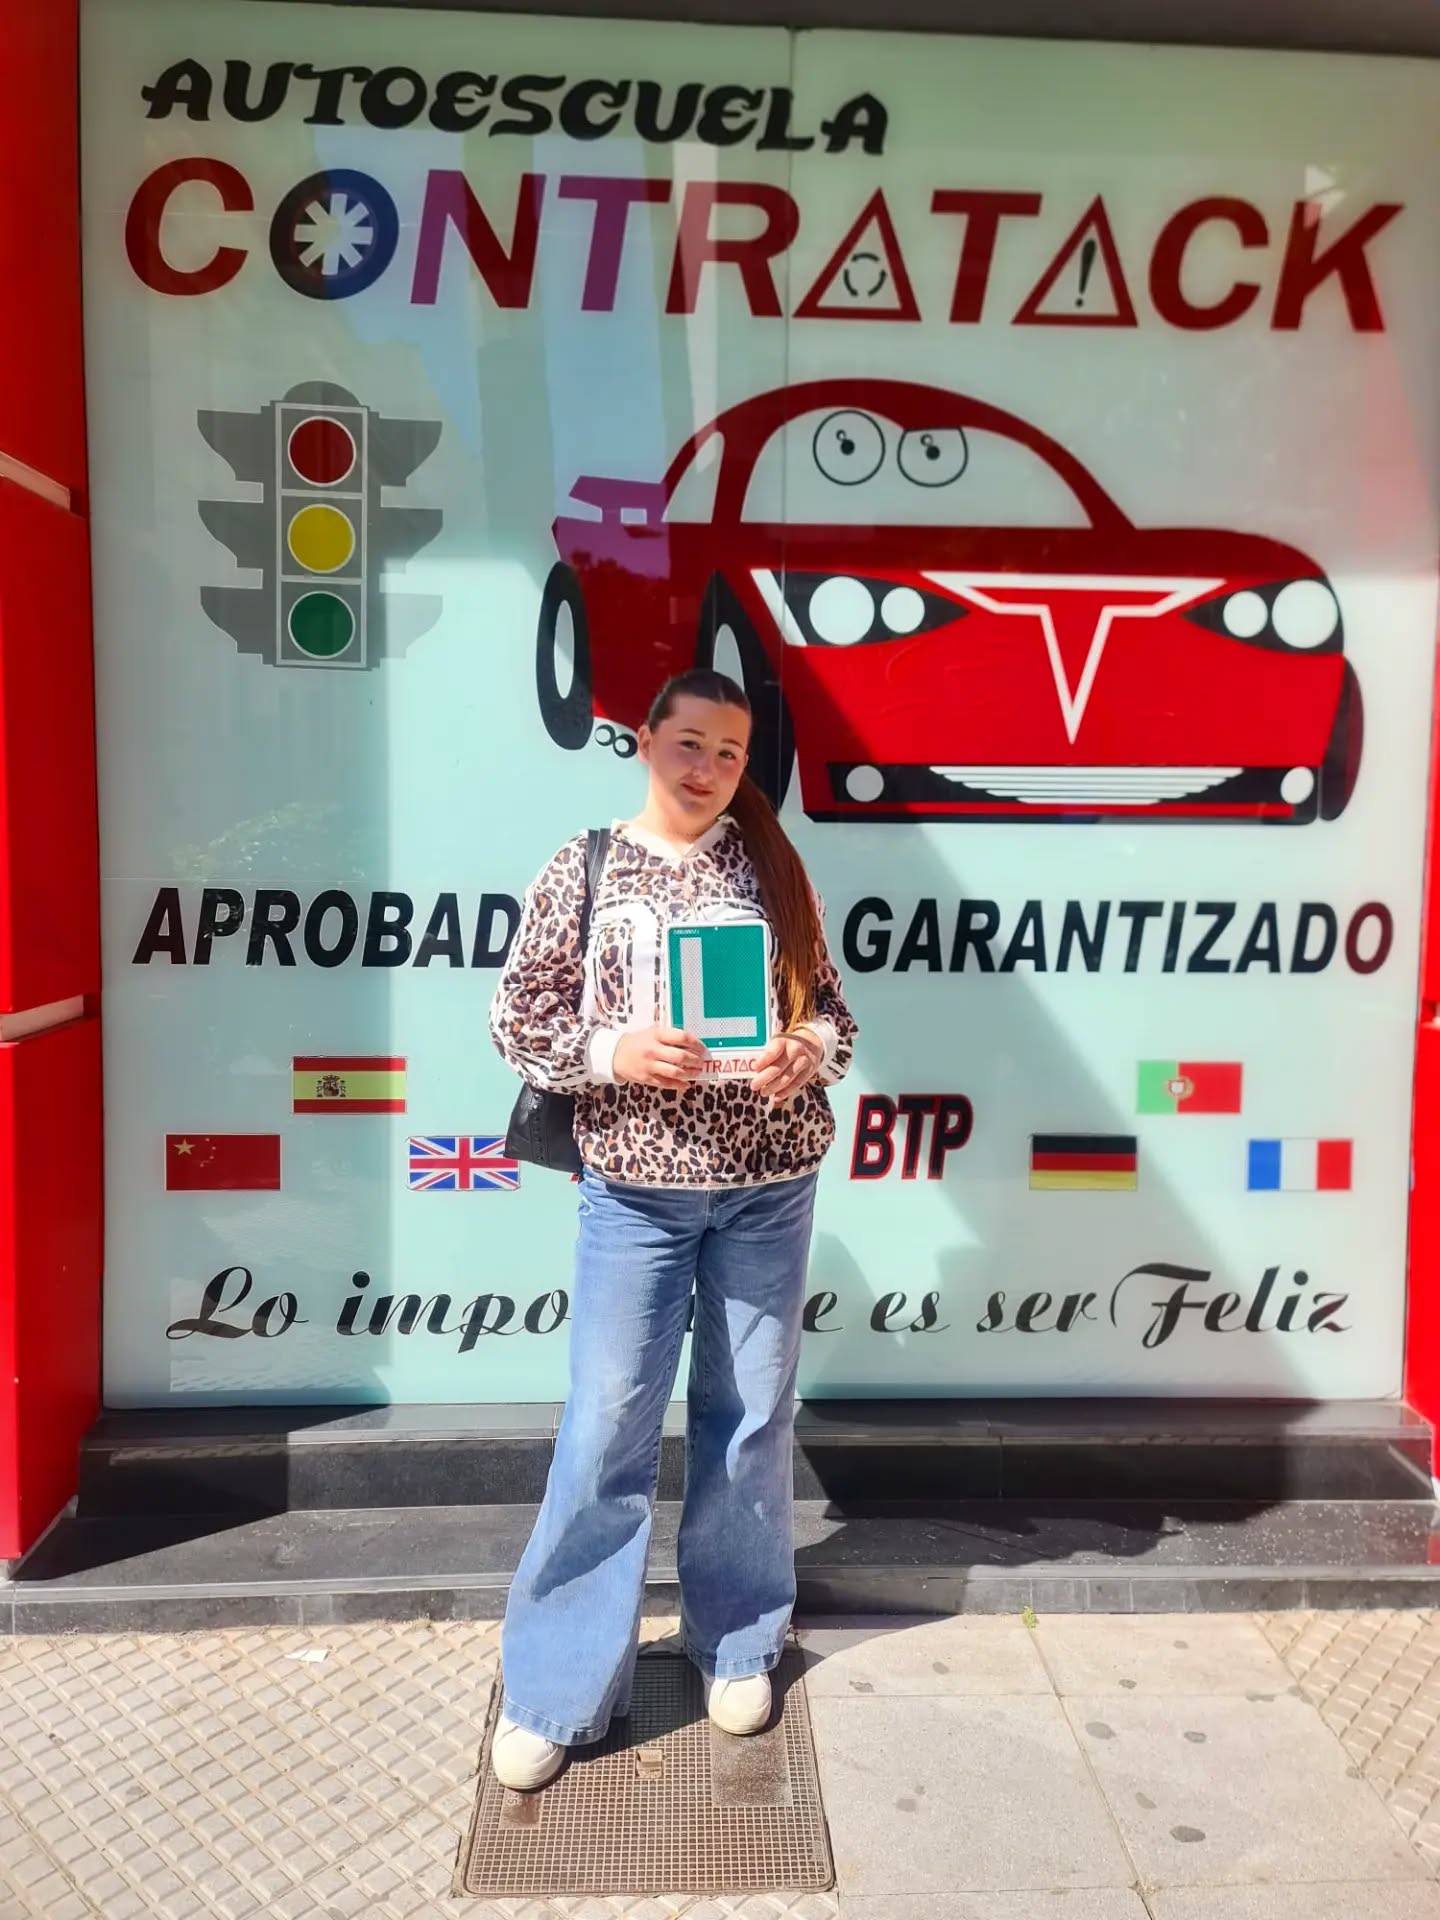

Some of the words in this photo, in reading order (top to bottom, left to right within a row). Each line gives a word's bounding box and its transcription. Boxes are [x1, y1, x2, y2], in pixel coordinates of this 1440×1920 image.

[141, 58, 889, 155] AUTOESCUELA
[124, 157, 1406, 333] CONTRATACK
[132, 887, 522, 969] APROBAD
[842, 896, 1395, 975] GARANTIZADO
[849, 1093, 975, 1181] BTP
[165, 1266, 308, 1339] Lo
[870, 1290, 950, 1334] es
[976, 1290, 1099, 1334] ser
[1110, 1262, 1353, 1350] Feliz
